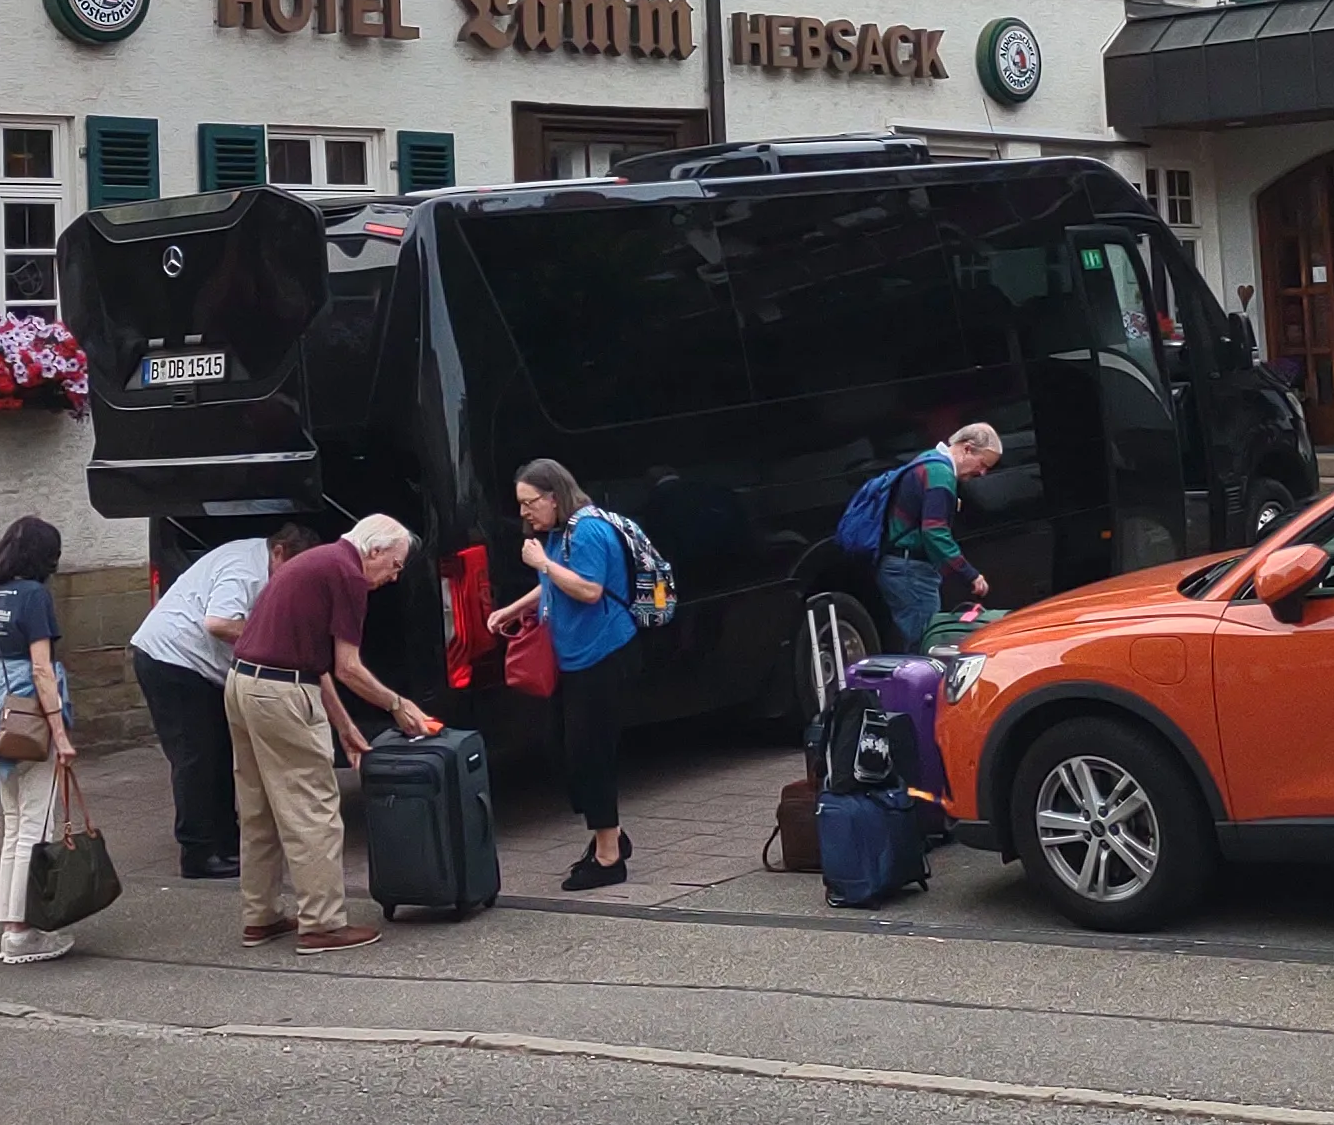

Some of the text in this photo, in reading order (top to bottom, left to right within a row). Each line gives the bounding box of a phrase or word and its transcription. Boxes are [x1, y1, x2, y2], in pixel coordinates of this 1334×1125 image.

[732, 12, 950, 79] HEBSACK
[151, 356, 223, 381] B DB 1515
